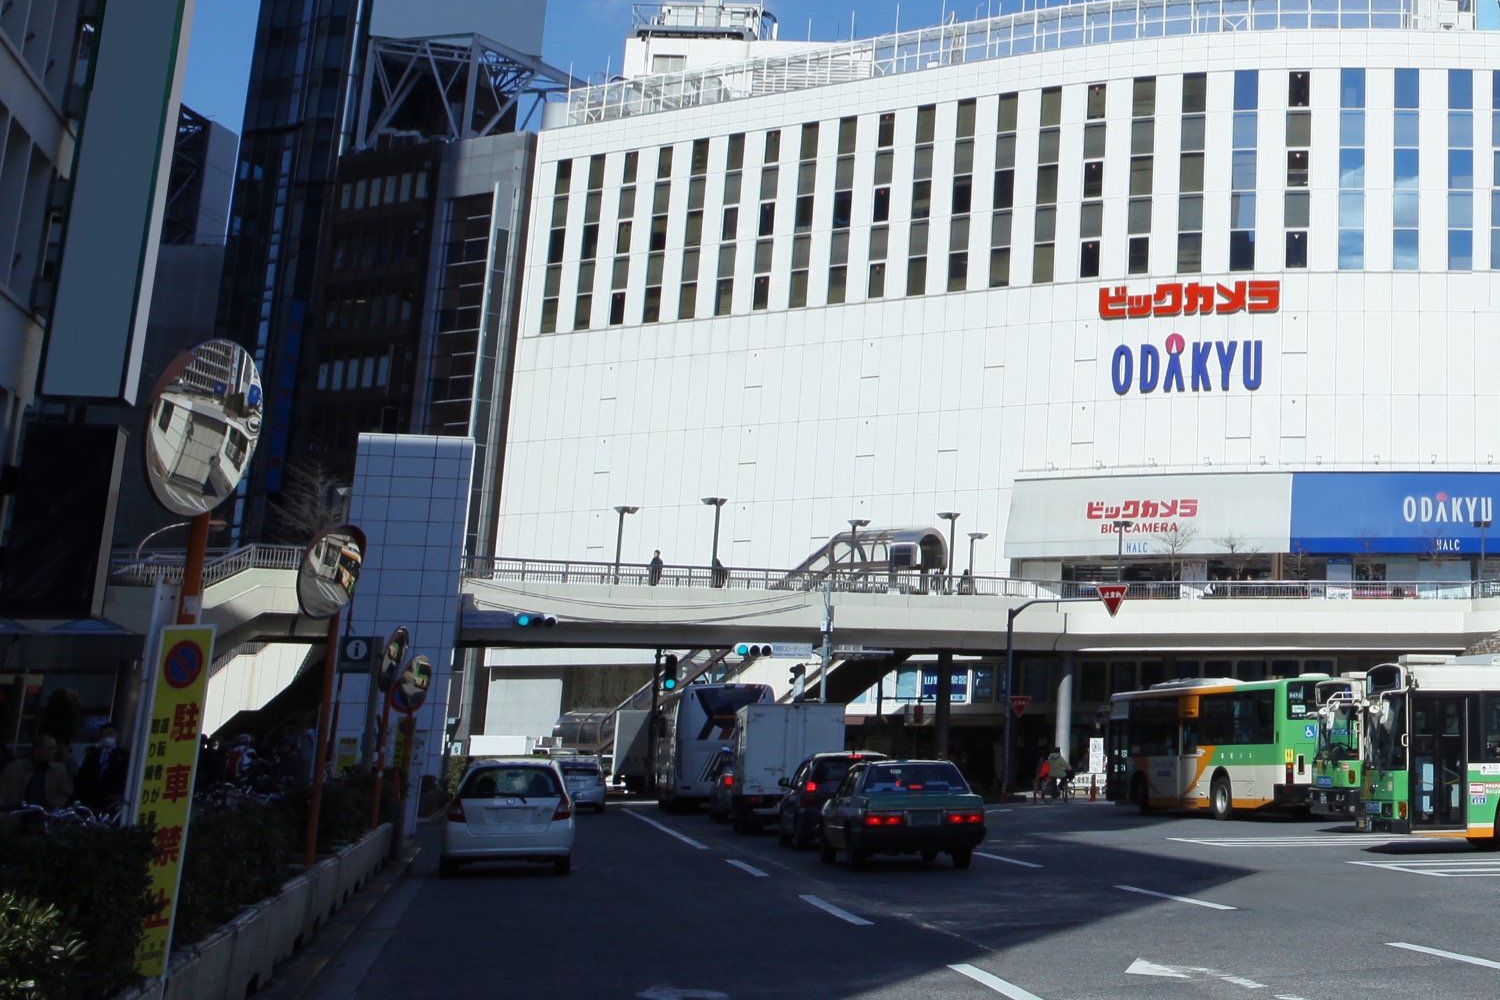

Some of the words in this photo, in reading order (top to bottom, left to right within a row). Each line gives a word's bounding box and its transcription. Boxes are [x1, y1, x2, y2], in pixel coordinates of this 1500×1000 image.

[1099, 280, 1281, 320] ビックカメラ
[1111, 333, 1263, 396] ODAKYU
[1086, 499, 1199, 519] ビックカメラ
[1403, 492, 1493, 523] ODAKYU
[1124, 522, 1179, 533] CAMERA
[1126, 542, 1148, 553] HALC
[1436, 539, 1460, 551] HALC
[1103, 591, 1121, 599] 止まれ
